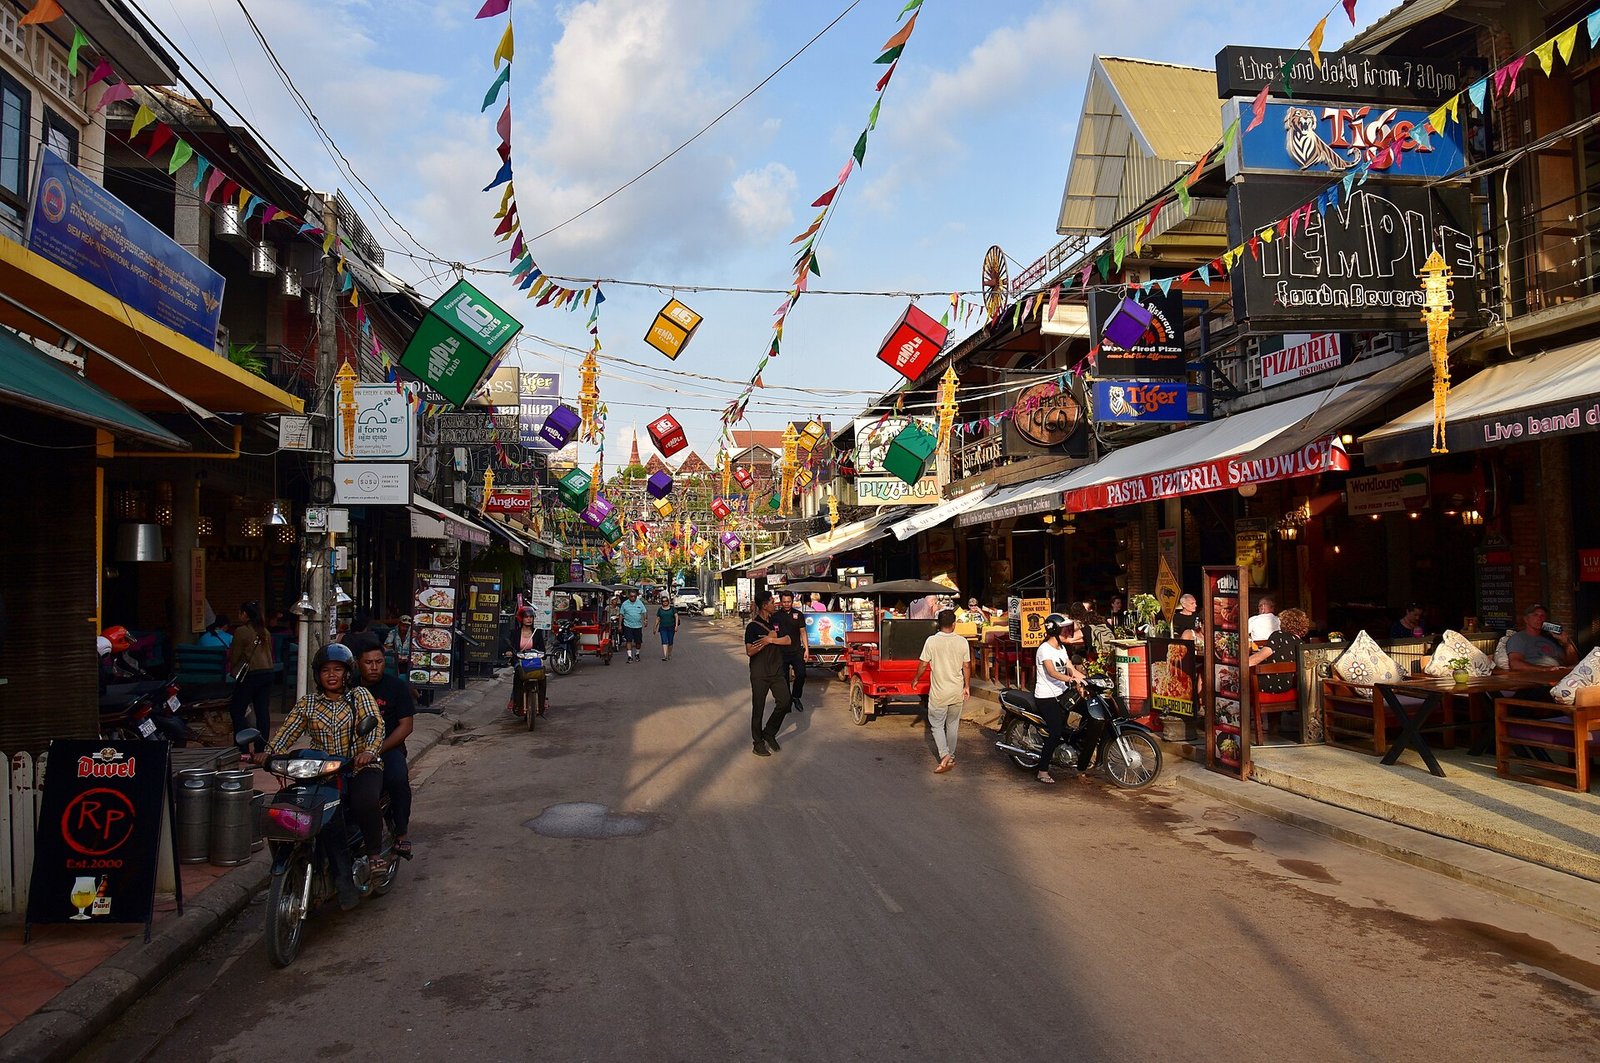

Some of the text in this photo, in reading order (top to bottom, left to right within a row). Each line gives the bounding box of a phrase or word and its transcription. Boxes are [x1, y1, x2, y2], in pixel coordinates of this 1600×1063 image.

[1239, 56, 1274, 81] Live
[1321, 56, 1358, 88] daily
[1363, 57, 1401, 88] from
[1254, 190, 1475, 279] TEMPLE
[95, 241, 130, 271] INTERNATIONAL
[130, 263, 150, 282] AIRPORT
[184, 297, 198, 312] OFFICE
[455, 296, 493, 333] 16
[1147, 303, 1175, 339] Ristorante
[478, 317, 502, 338] years
[653, 326, 679, 347] TEMPLE
[427, 336, 461, 383] TEMPLE
[896, 336, 923, 368] TEMPLE
[1158, 345, 1182, 353] Pizza
[1262, 333, 1340, 379] PIZZERIA
[446, 358, 461, 377] Club
[1300, 358, 1340, 376] RISTORANTE
[520, 373, 553, 393] iger
[1127, 385, 1178, 411] Tiger
[364, 425, 388, 434] forno
[1026, 407, 1067, 434] 1960
[1484, 421, 1523, 443] Live
[1528, 408, 1580, 435] band
[545, 425, 564, 442] TEMPLE
[665, 436, 684, 449] TEMPLE
[1107, 434, 1336, 505] PASTA PIZZERIA SANDWICH
[860, 480, 939, 501] PIZZERIA
[487, 496, 530, 509] Angkor
[77, 756, 136, 779] Duvel
[78, 801, 126, 840] RP
[66, 858, 123, 869] Est.2000
[93, 900, 110, 909] Duvel
